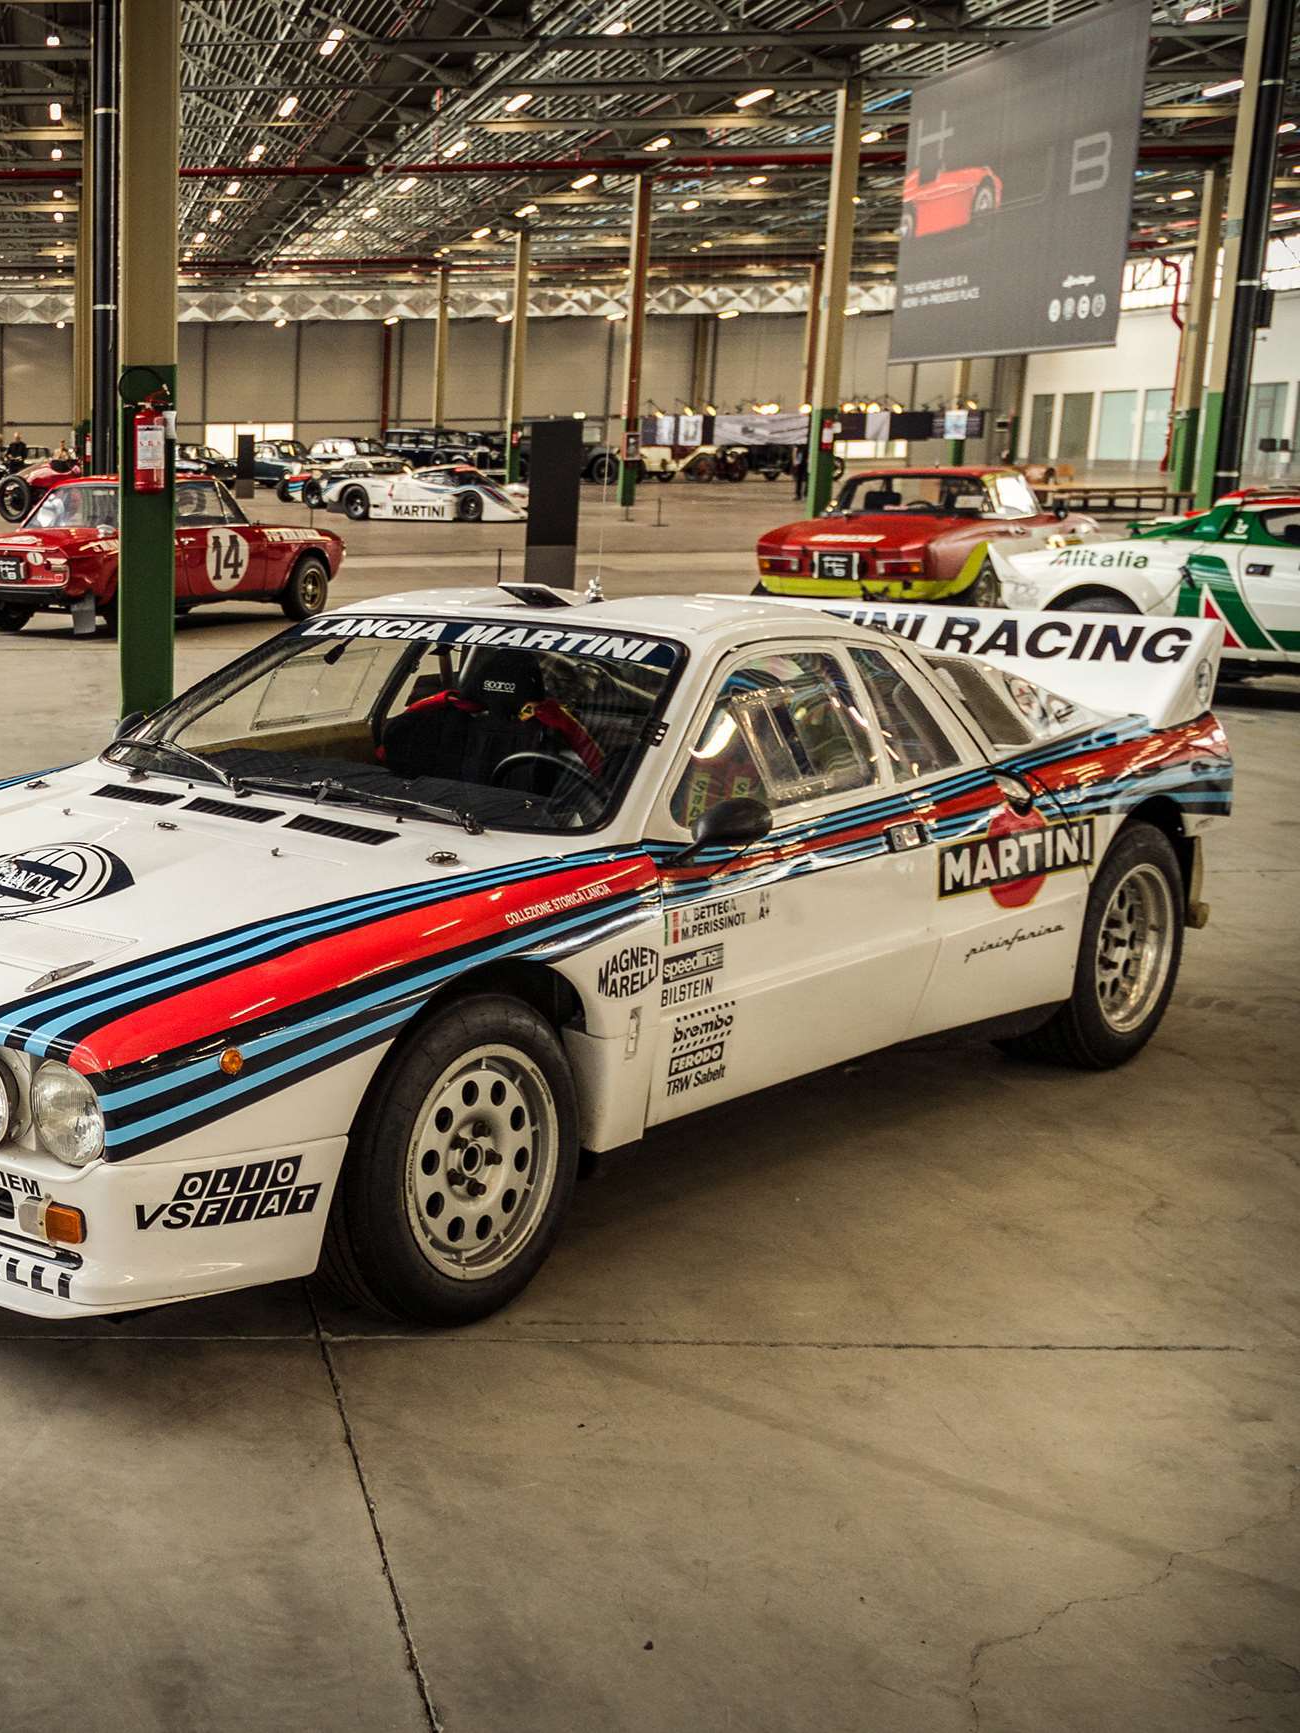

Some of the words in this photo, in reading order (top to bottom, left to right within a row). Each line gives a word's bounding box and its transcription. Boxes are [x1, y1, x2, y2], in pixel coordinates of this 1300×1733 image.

[1069, 131, 1112, 195] B
[392, 505, 445, 518] MARTINI
[212, 534, 244, 580] 14
[1050, 549, 1149, 569] Alitalia
[301, 618, 448, 645] LANCIA
[454, 624, 660, 662] MARTINI
[935, 615, 1192, 664] RACING
[483, 680, 516, 691] sparco
[943, 823, 1091, 892] MARTINI
[505, 901, 554, 925] COLLEZIONE
[551, 890, 586, 911] STORICA
[583, 883, 612, 900] LANCIA
[694, 898, 737, 921] BETTEGA
[681, 912, 746, 941] M.PERISSINOT
[964, 922, 1066, 963] pininfarina
[661, 976, 714, 1008] BILSTEIN
[672, 1014, 734, 1044] brembo
[671, 1046, 723, 1074] FERODO
[667, 1075, 693, 1097] TRW
[693, 1064, 726, 1088] Sabelt
[183, 1162, 295, 1197] OLIO
